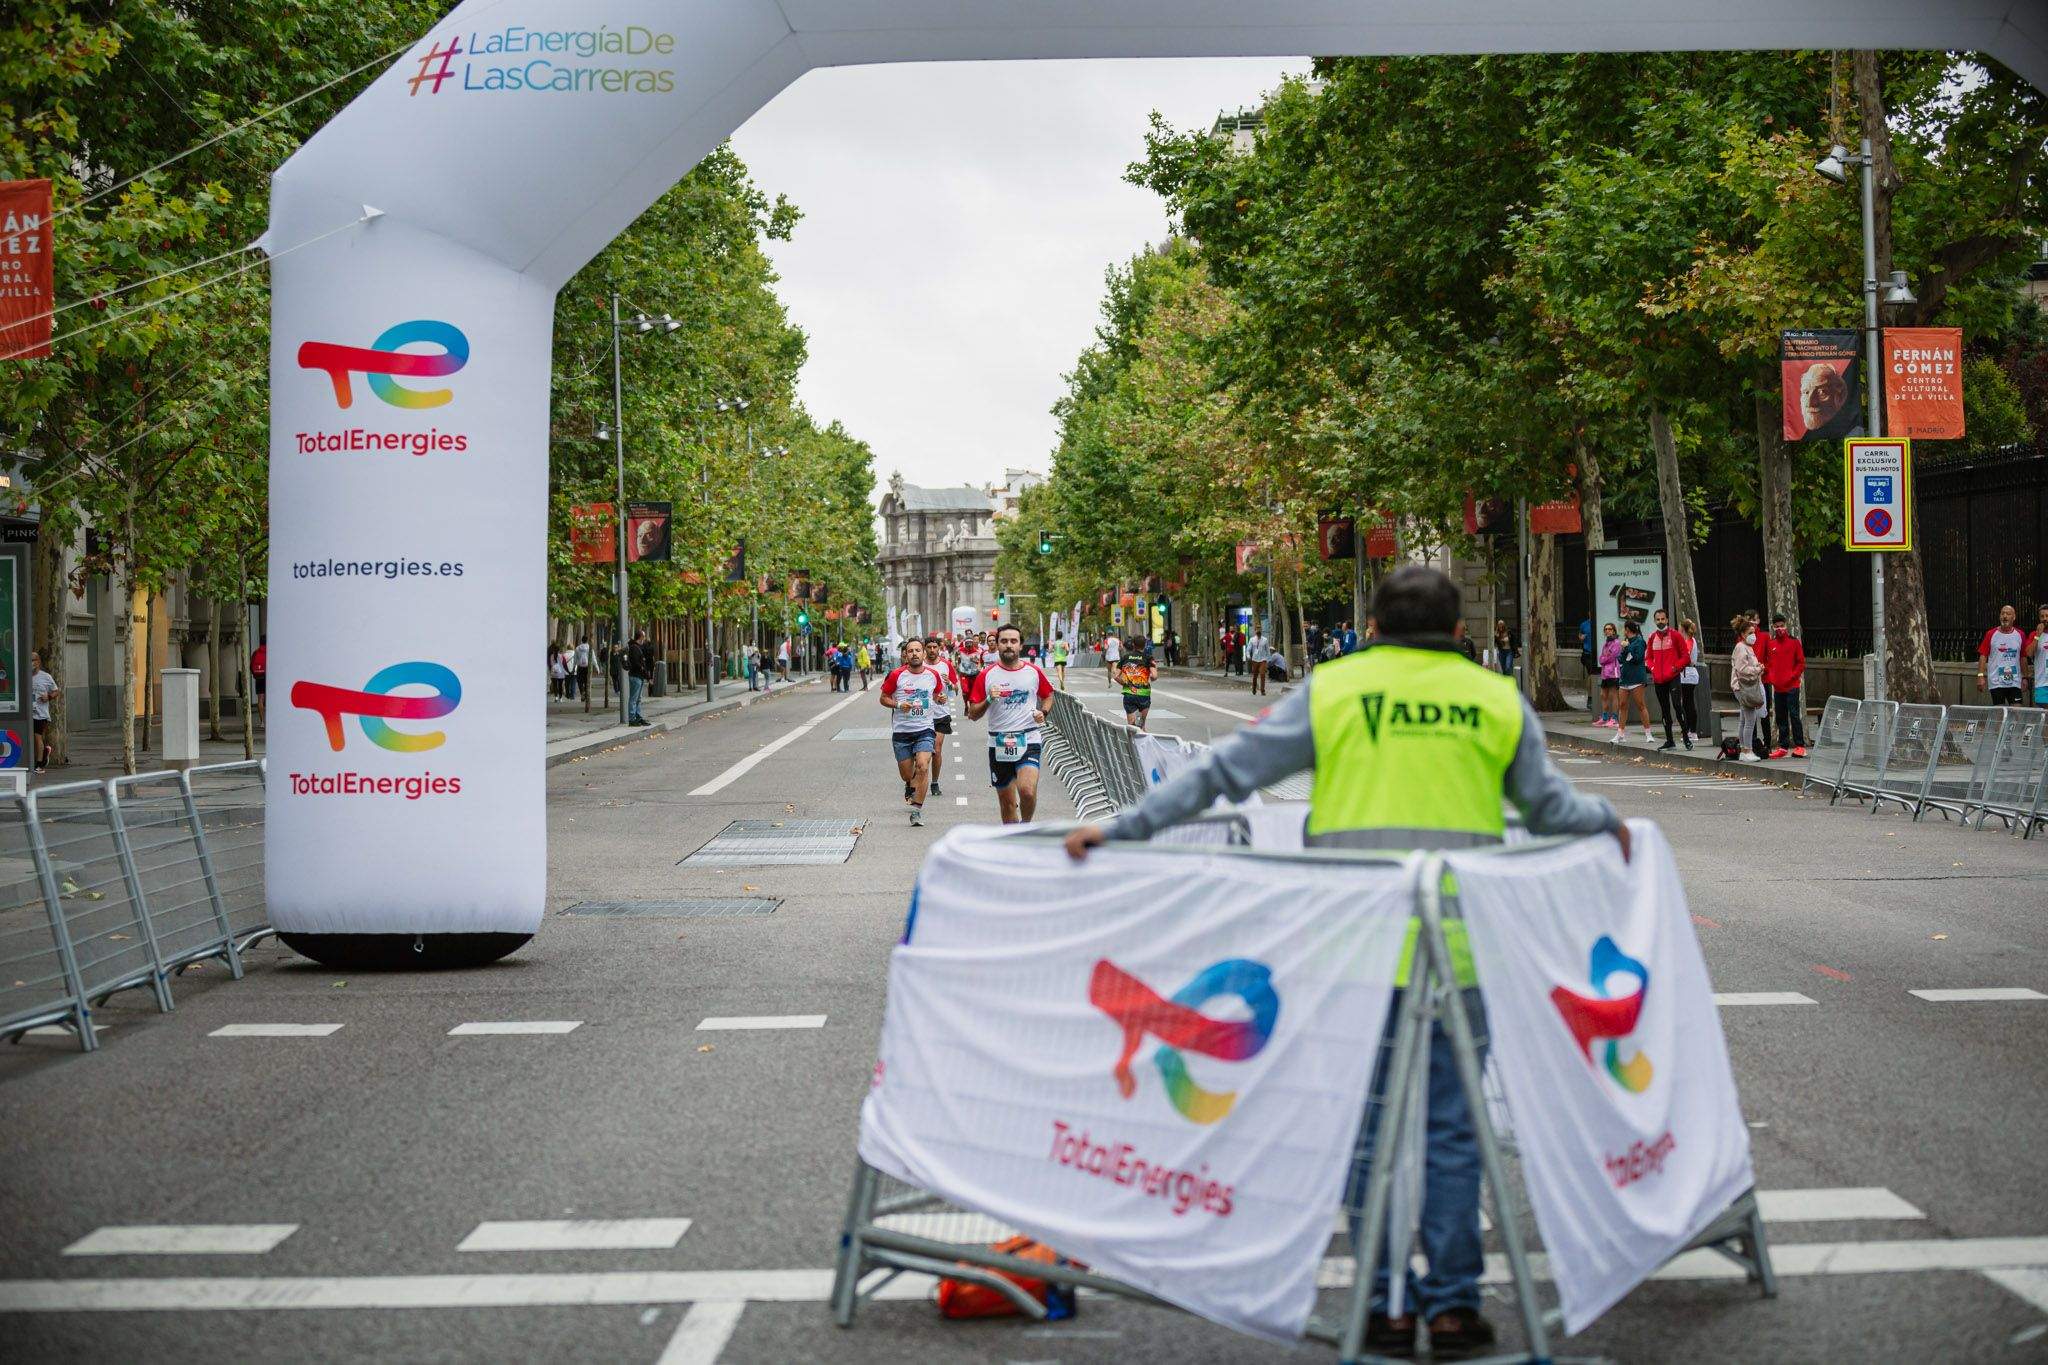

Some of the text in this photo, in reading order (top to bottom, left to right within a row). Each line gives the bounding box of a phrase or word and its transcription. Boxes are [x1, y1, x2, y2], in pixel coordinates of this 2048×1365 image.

[464, 59, 675, 93] LasCarreras
[0, 236, 41, 255] EZ
[1893, 346, 1953, 361] FERNÁN
[1893, 360, 1954, 374] GÓMEZ
[295, 428, 468, 456] TotalEnergies
[7, 529, 38, 537] PINK
[293, 558, 464, 580] totalenergies.es
[911, 708, 924, 716] 508
[1391, 703, 1480, 728] ADM
[1004, 747, 1018, 756] 491
[289, 772, 461, 800] TotalEnergies
[1051, 1119, 1234, 1217] TotalEnergies
